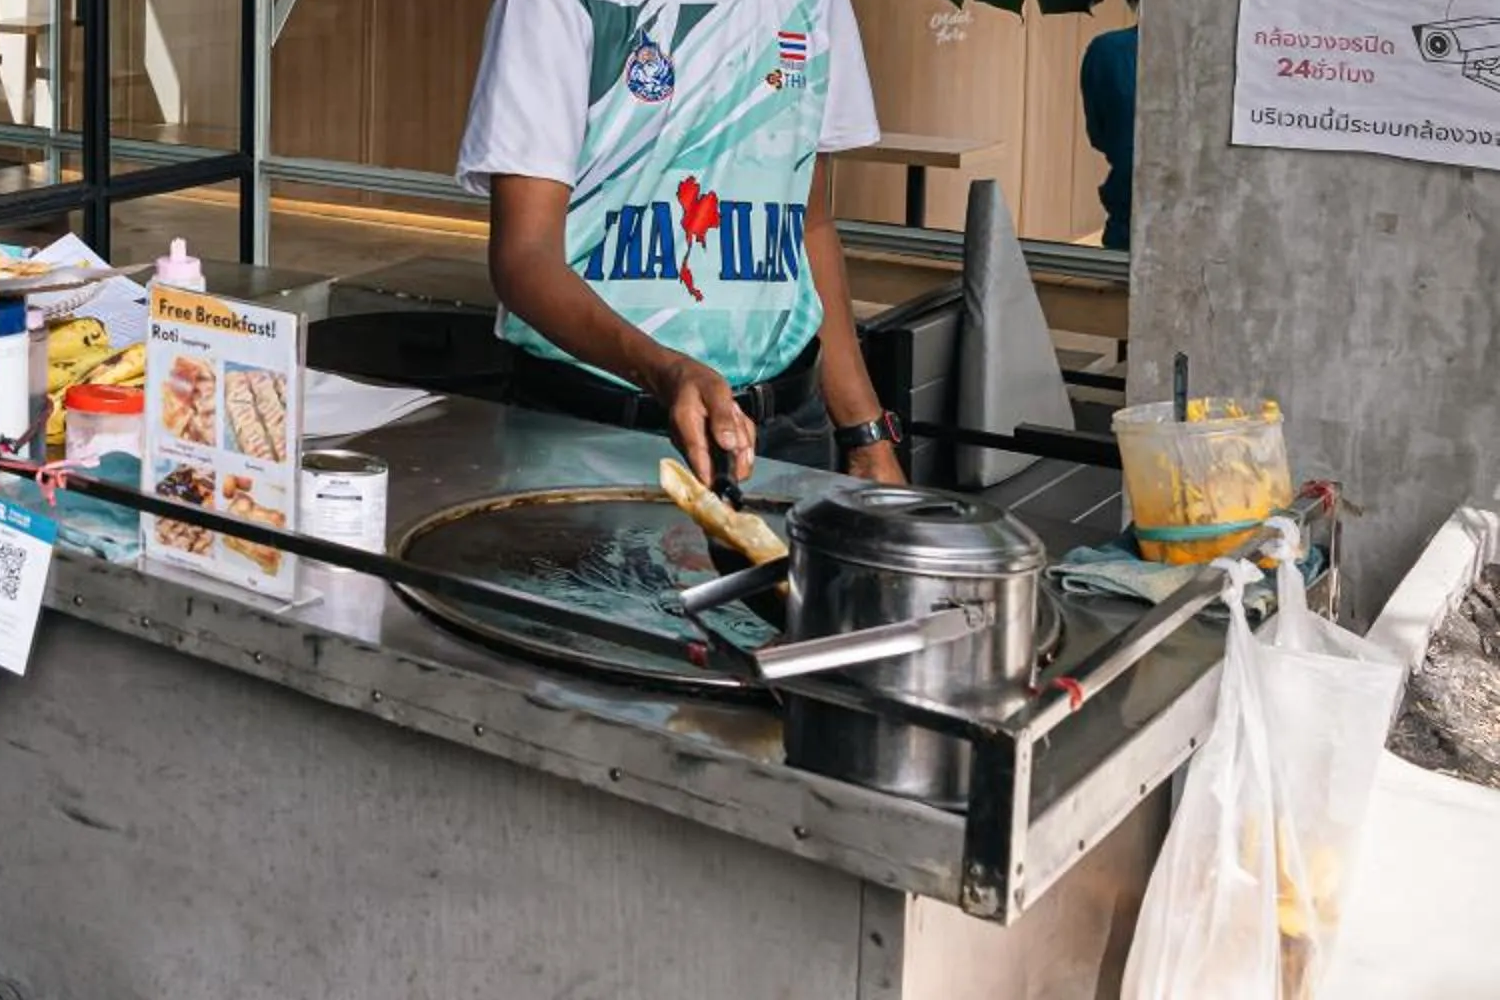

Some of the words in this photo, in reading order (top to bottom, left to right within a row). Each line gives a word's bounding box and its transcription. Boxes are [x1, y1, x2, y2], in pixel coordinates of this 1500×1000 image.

[1254, 27, 1395, 55] กล้องวงจรปิด
[152, 323, 179, 342] Roti
[159, 298, 192, 320] Free
[195, 305, 277, 339] Breakfast!
